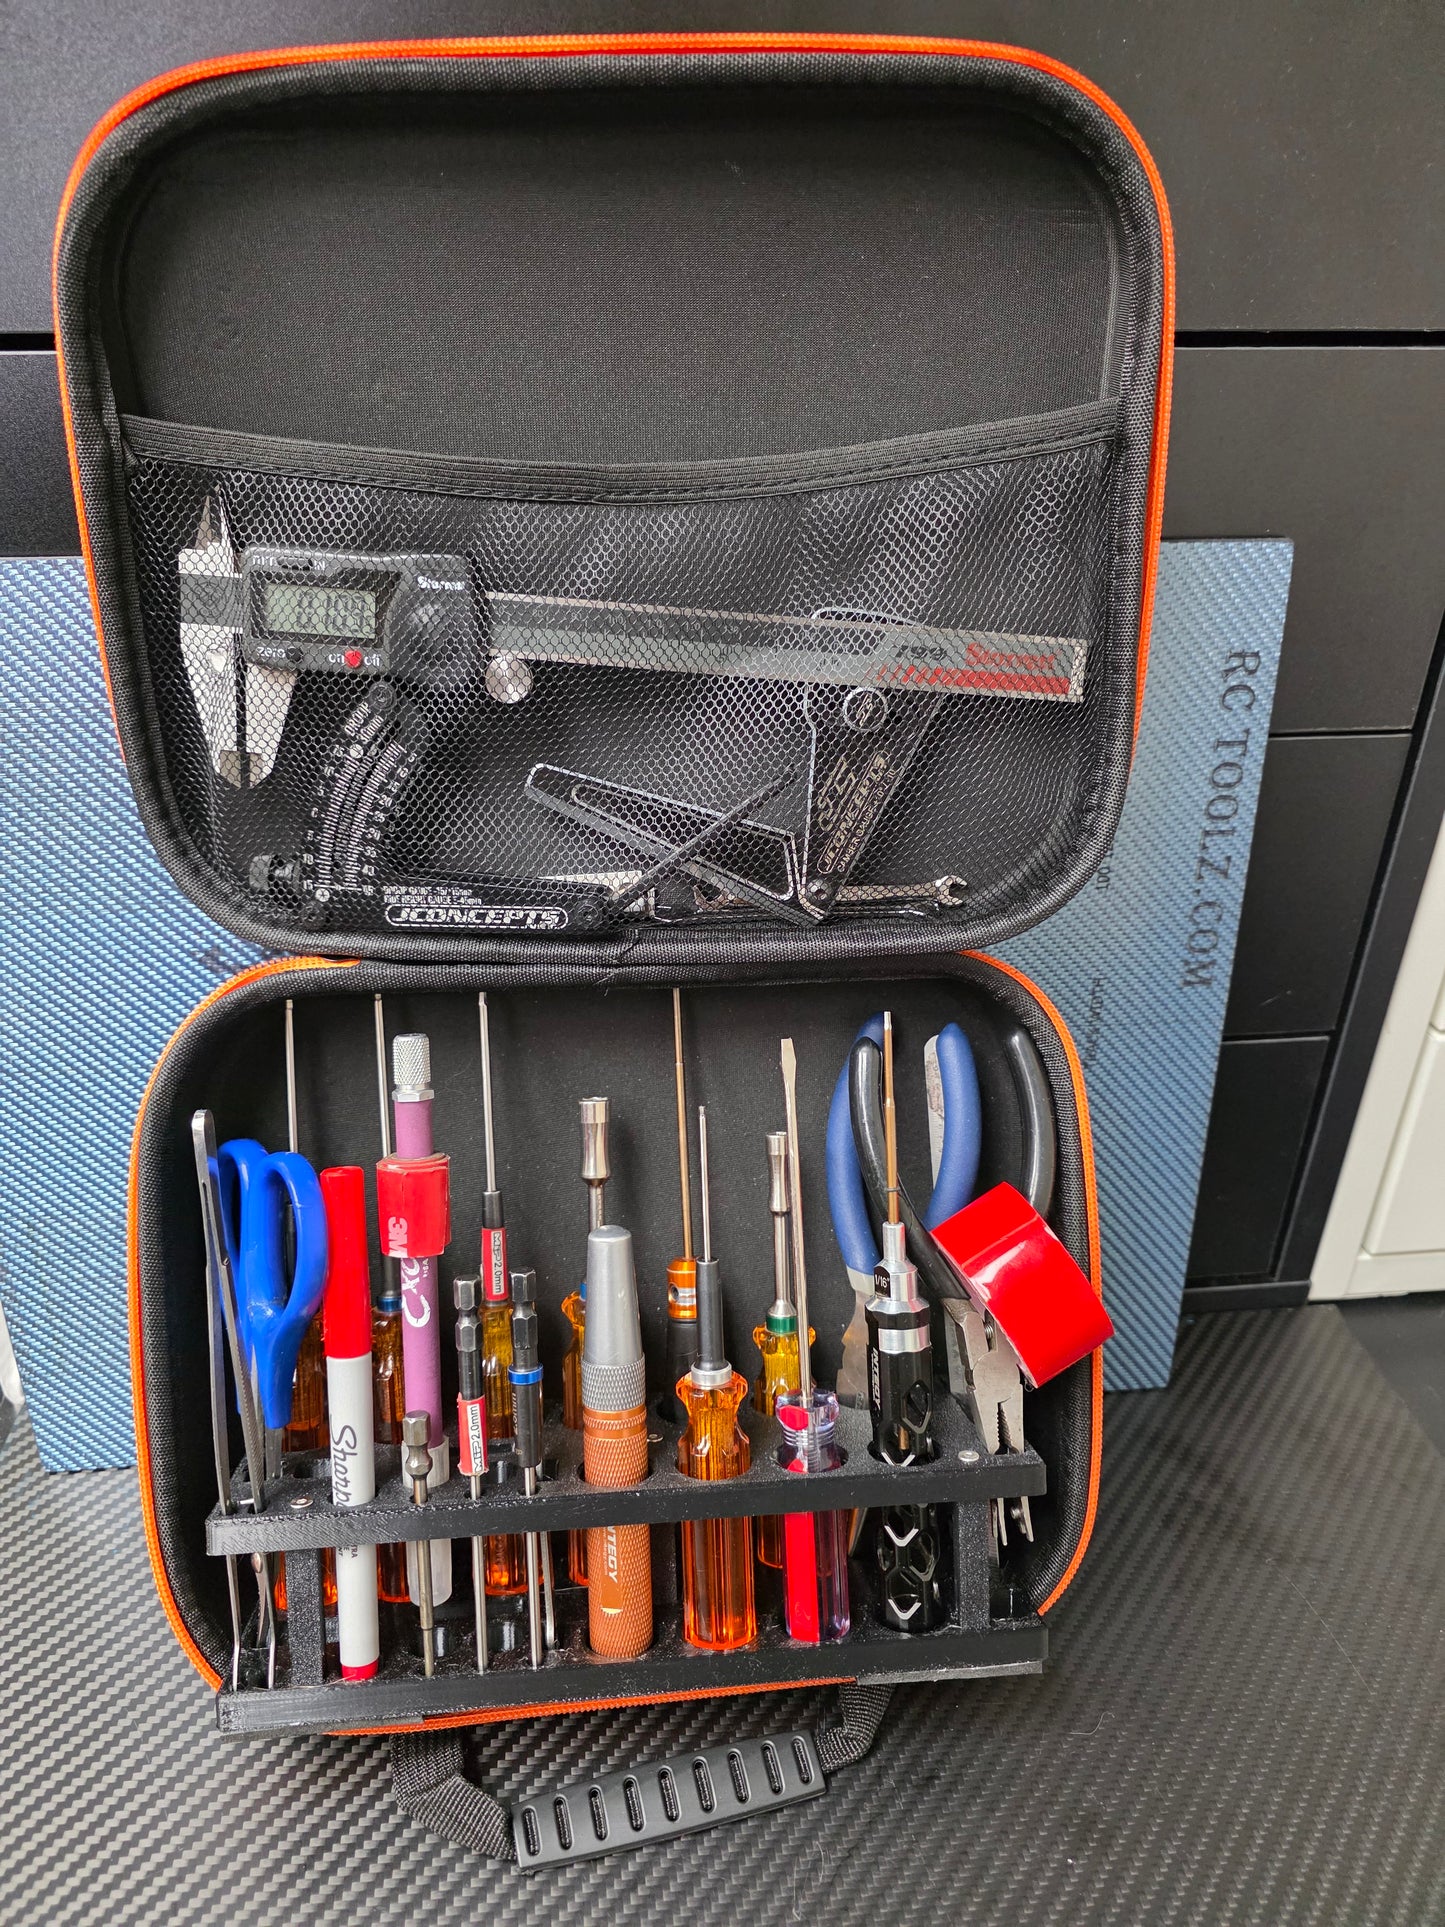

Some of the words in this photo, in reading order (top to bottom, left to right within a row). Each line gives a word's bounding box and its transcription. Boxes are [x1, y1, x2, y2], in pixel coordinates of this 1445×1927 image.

[257, 646, 285, 658] zero
[328, 653, 345, 664] on
[1220, 650, 1261, 712] RC
[1181, 727, 1251, 988] TOOLZ.COM
[391, 907, 561, 927] JCONCEPTS
[387, 1216, 409, 1258] 3M
[494, 1263, 504, 1294] 2.0mm
[872, 1346, 881, 1411] INTEGY
[470, 1404, 480, 1438] 2.0mm
